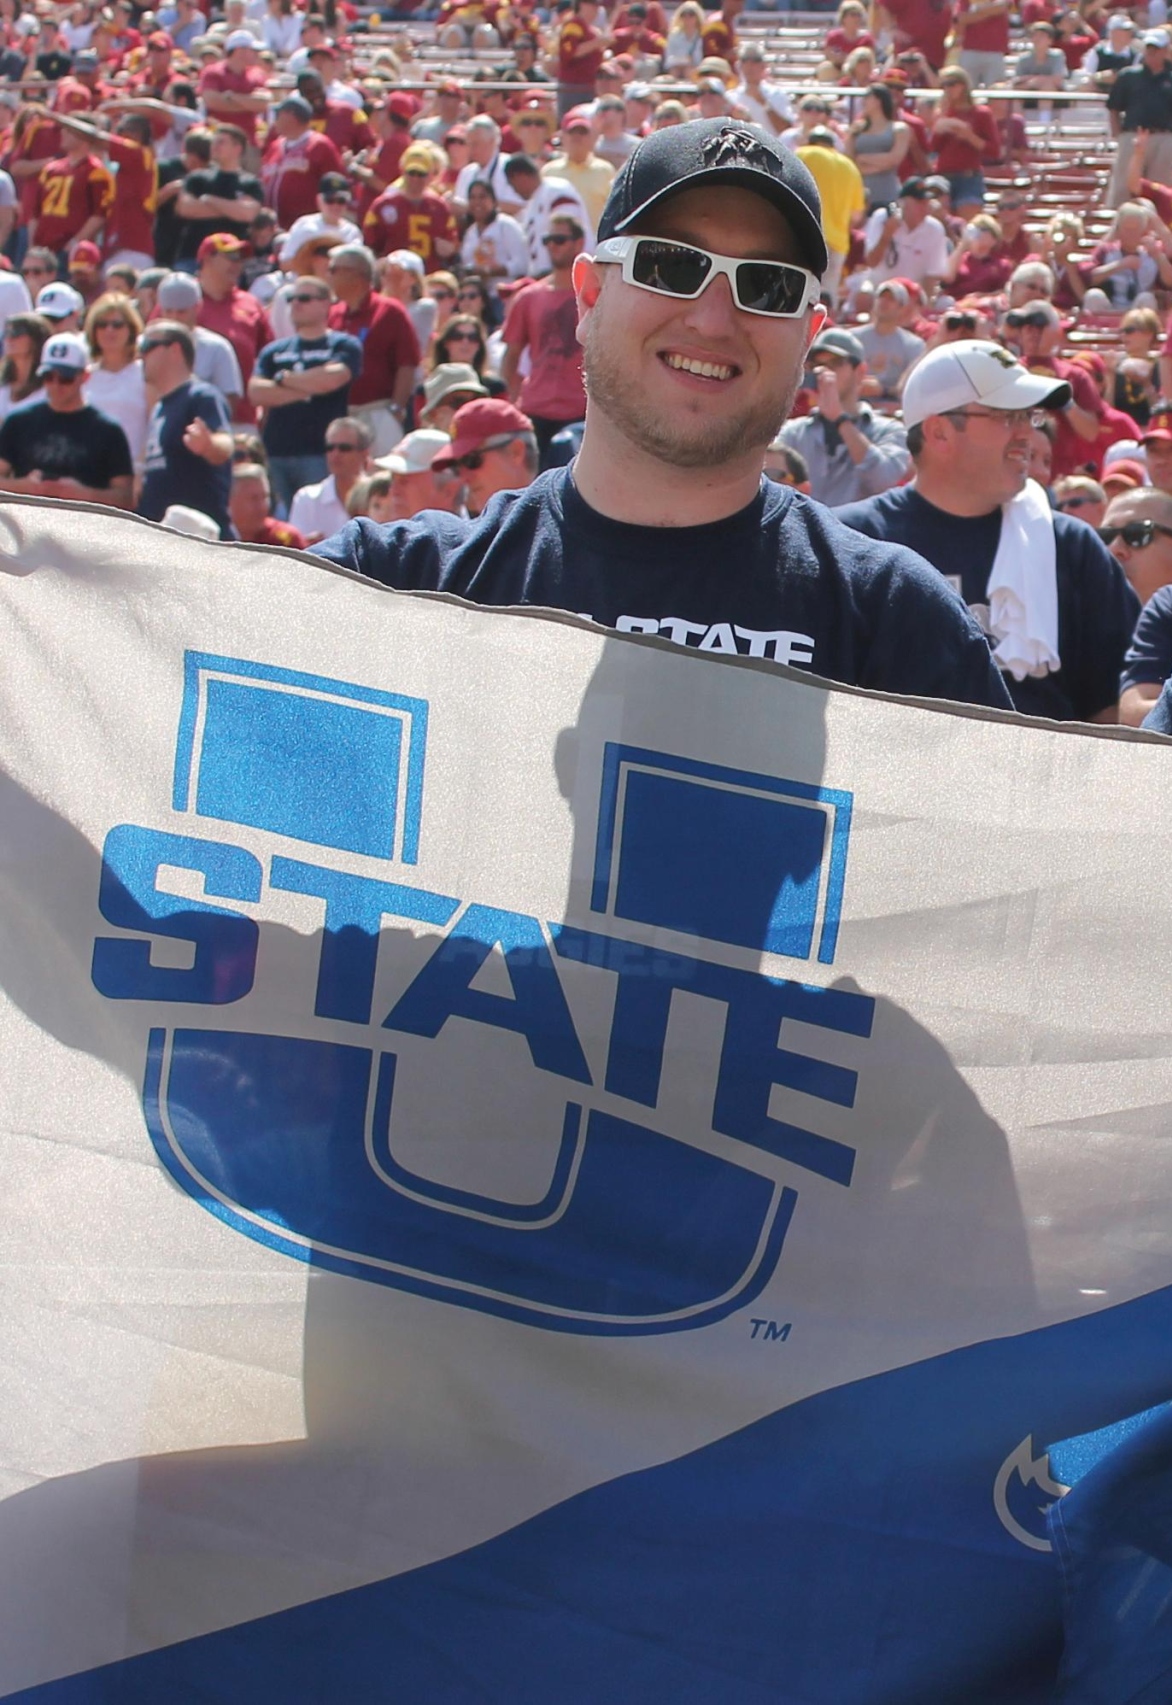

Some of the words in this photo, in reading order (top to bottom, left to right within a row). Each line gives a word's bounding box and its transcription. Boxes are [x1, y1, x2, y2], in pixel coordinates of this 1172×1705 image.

[41, 174, 75, 216] 21
[408, 214, 432, 259] 5
[91, 823, 876, 1187] STATE
[750, 1318, 792, 1342] TM
